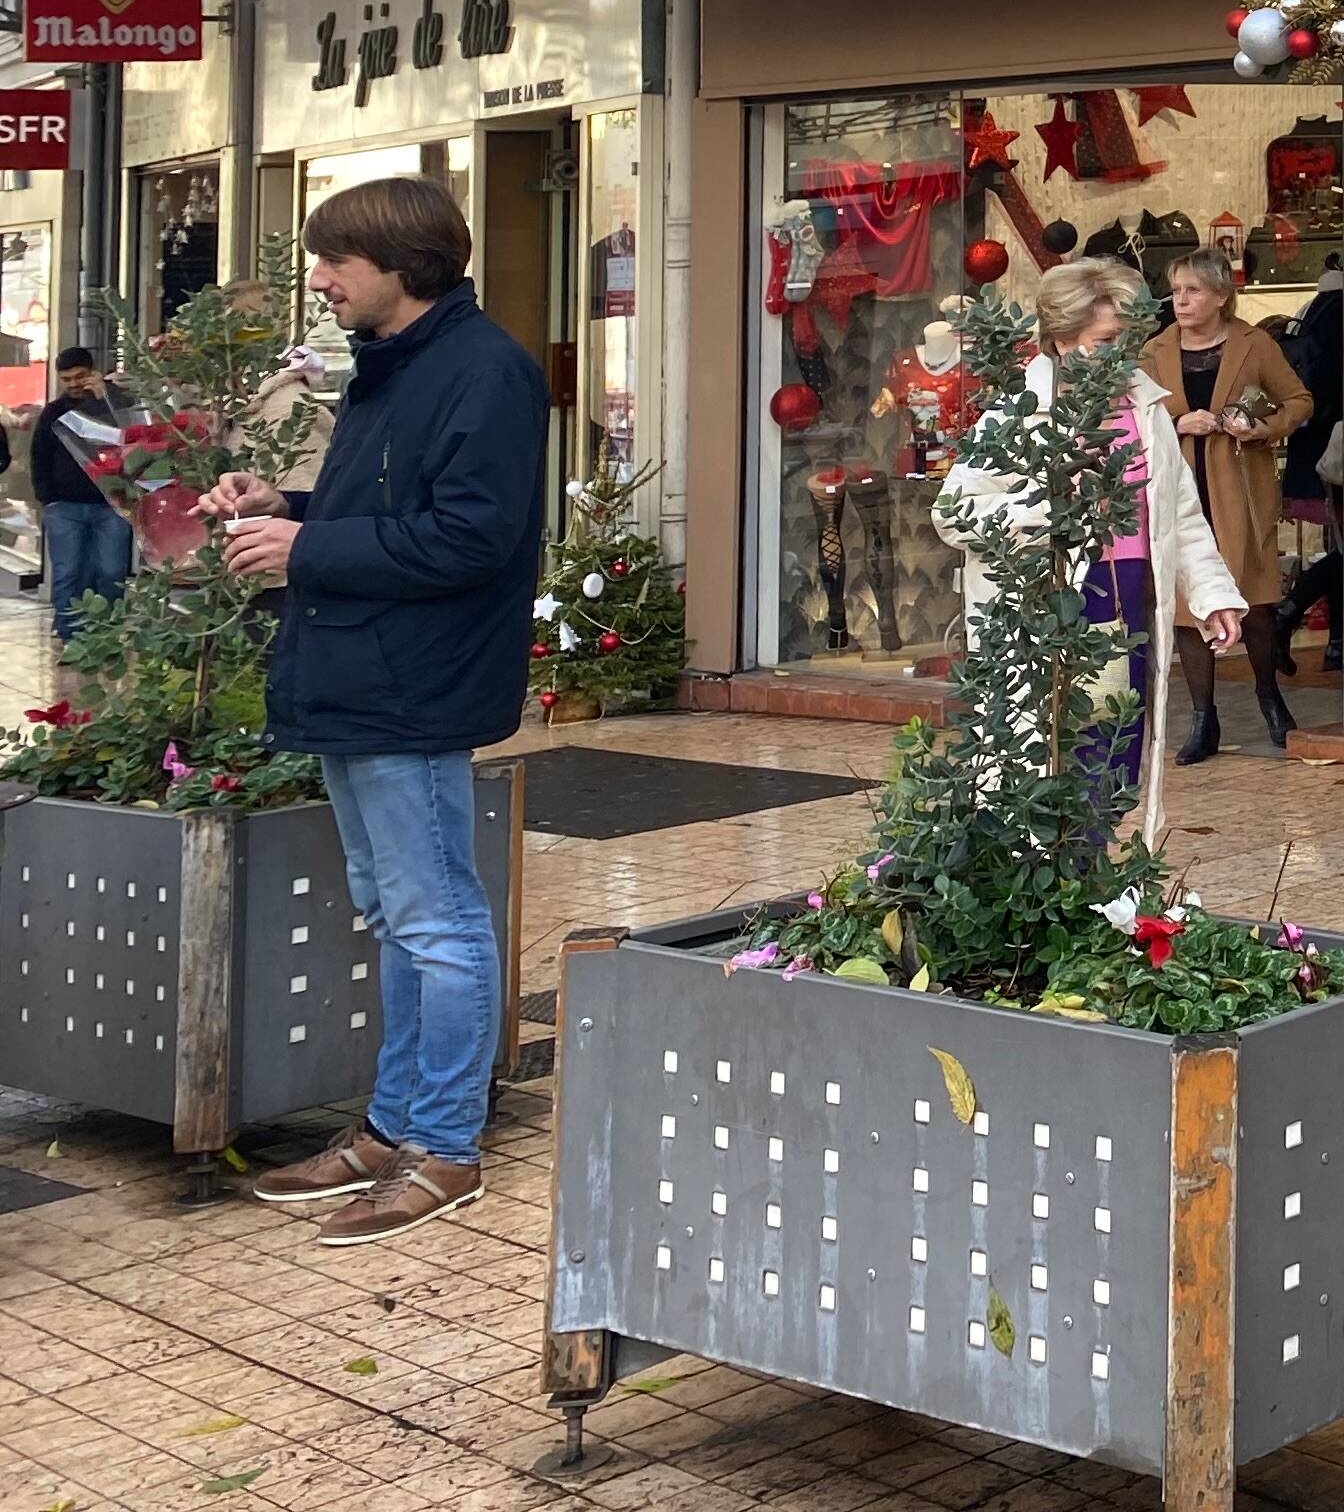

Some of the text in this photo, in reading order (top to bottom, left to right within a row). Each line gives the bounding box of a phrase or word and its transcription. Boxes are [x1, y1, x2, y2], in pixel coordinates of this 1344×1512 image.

[33, 16, 196, 55] Malongo
[312, 11, 348, 91] La
[0, 115, 66, 144] SFR
